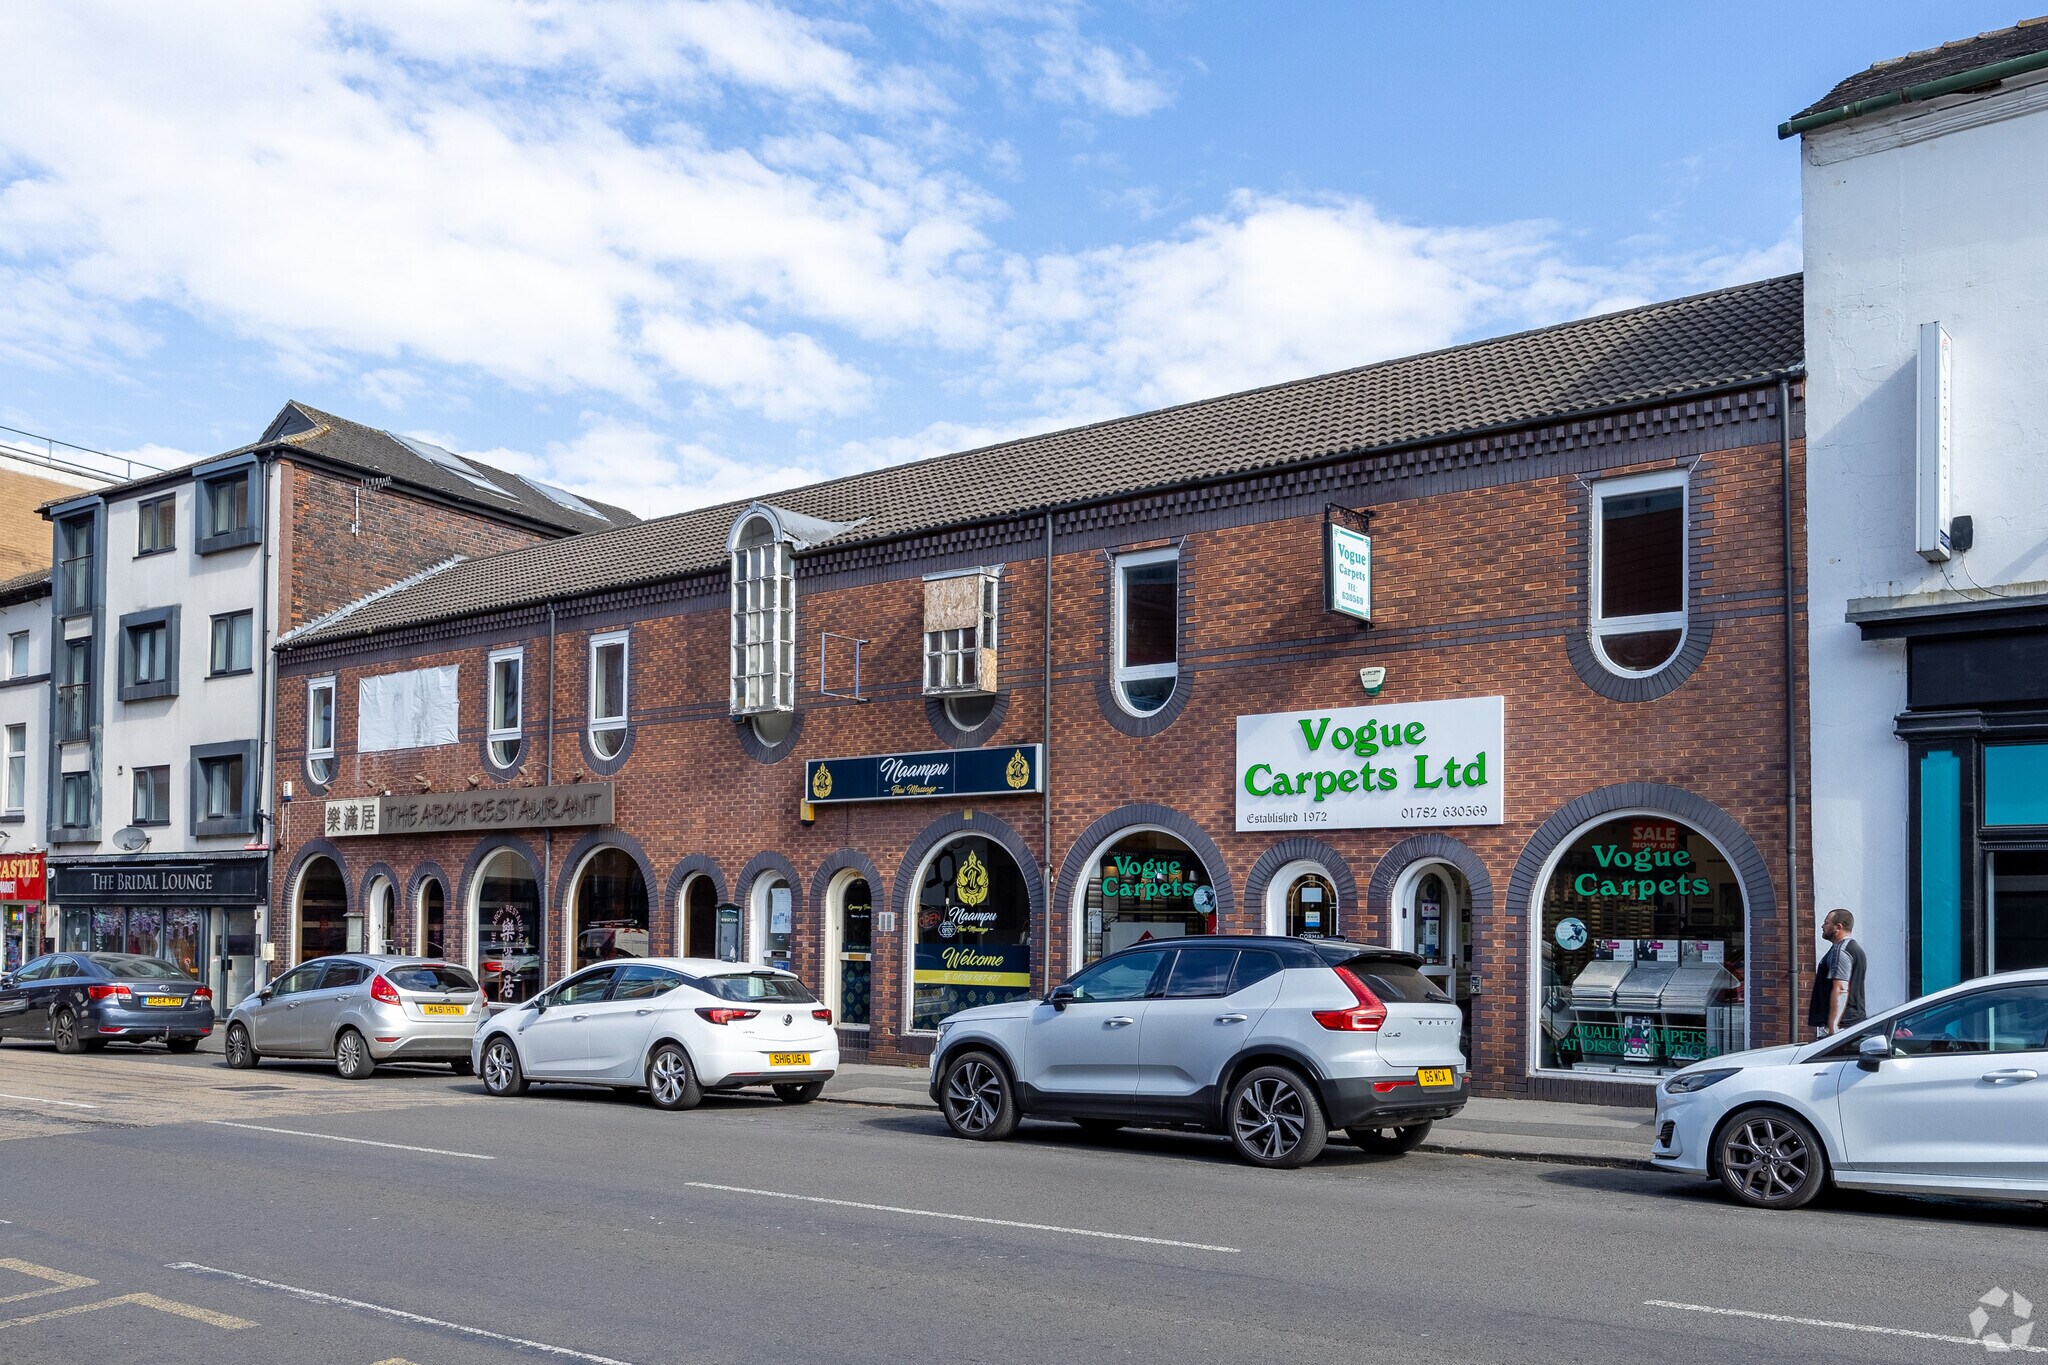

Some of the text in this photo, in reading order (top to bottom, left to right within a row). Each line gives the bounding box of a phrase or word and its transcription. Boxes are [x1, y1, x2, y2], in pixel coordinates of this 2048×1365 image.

[1338, 543, 1366, 565] Vogue
[1339, 563, 1365, 581] Carpets
[1342, 591, 1364, 605] 630569
[1298, 717, 1426, 756] Vogue
[880, 757, 950, 785] Naampu
[1244, 751, 1488, 801] Carpets Ltd
[891, 784, 937, 795] Thai Massage
[326, 804, 376, 832] 樂滿居
[385, 793, 602, 829] THE ARCH RESTAURANT
[1246, 811, 1327, 825] Established 1972
[1401, 805, 1488, 819] 01782 630569
[1632, 827, 1676, 841] SALE
[1114, 856, 1181, 879] Vogue
[1591, 844, 1691, 872] Vogue
[0, 859, 39, 878] ASTLE
[91, 872, 213, 890] THE BRIDAL LOUNGE
[1102, 876, 1194, 900] Carpets
[1574, 873, 1710, 900] Carpets
[492, 908, 504, 926] ARCH
[919, 913, 941, 926] OPEN
[949, 907, 998, 927] Naampu
[942, 947, 1004, 969] Welcome
[1573, 1025, 1635, 1039] QUALITY
[1640, 1028, 1708, 1044] CARPETS
[774, 1054, 807, 1064] SH16 UEA
[1562, 1039, 1578, 1051] AT
[1584, 1040, 1661, 1056] DISCOUNT
[1665, 1044, 1719, 1060] PRICES
[1424, 1070, 1434, 1083] G5
